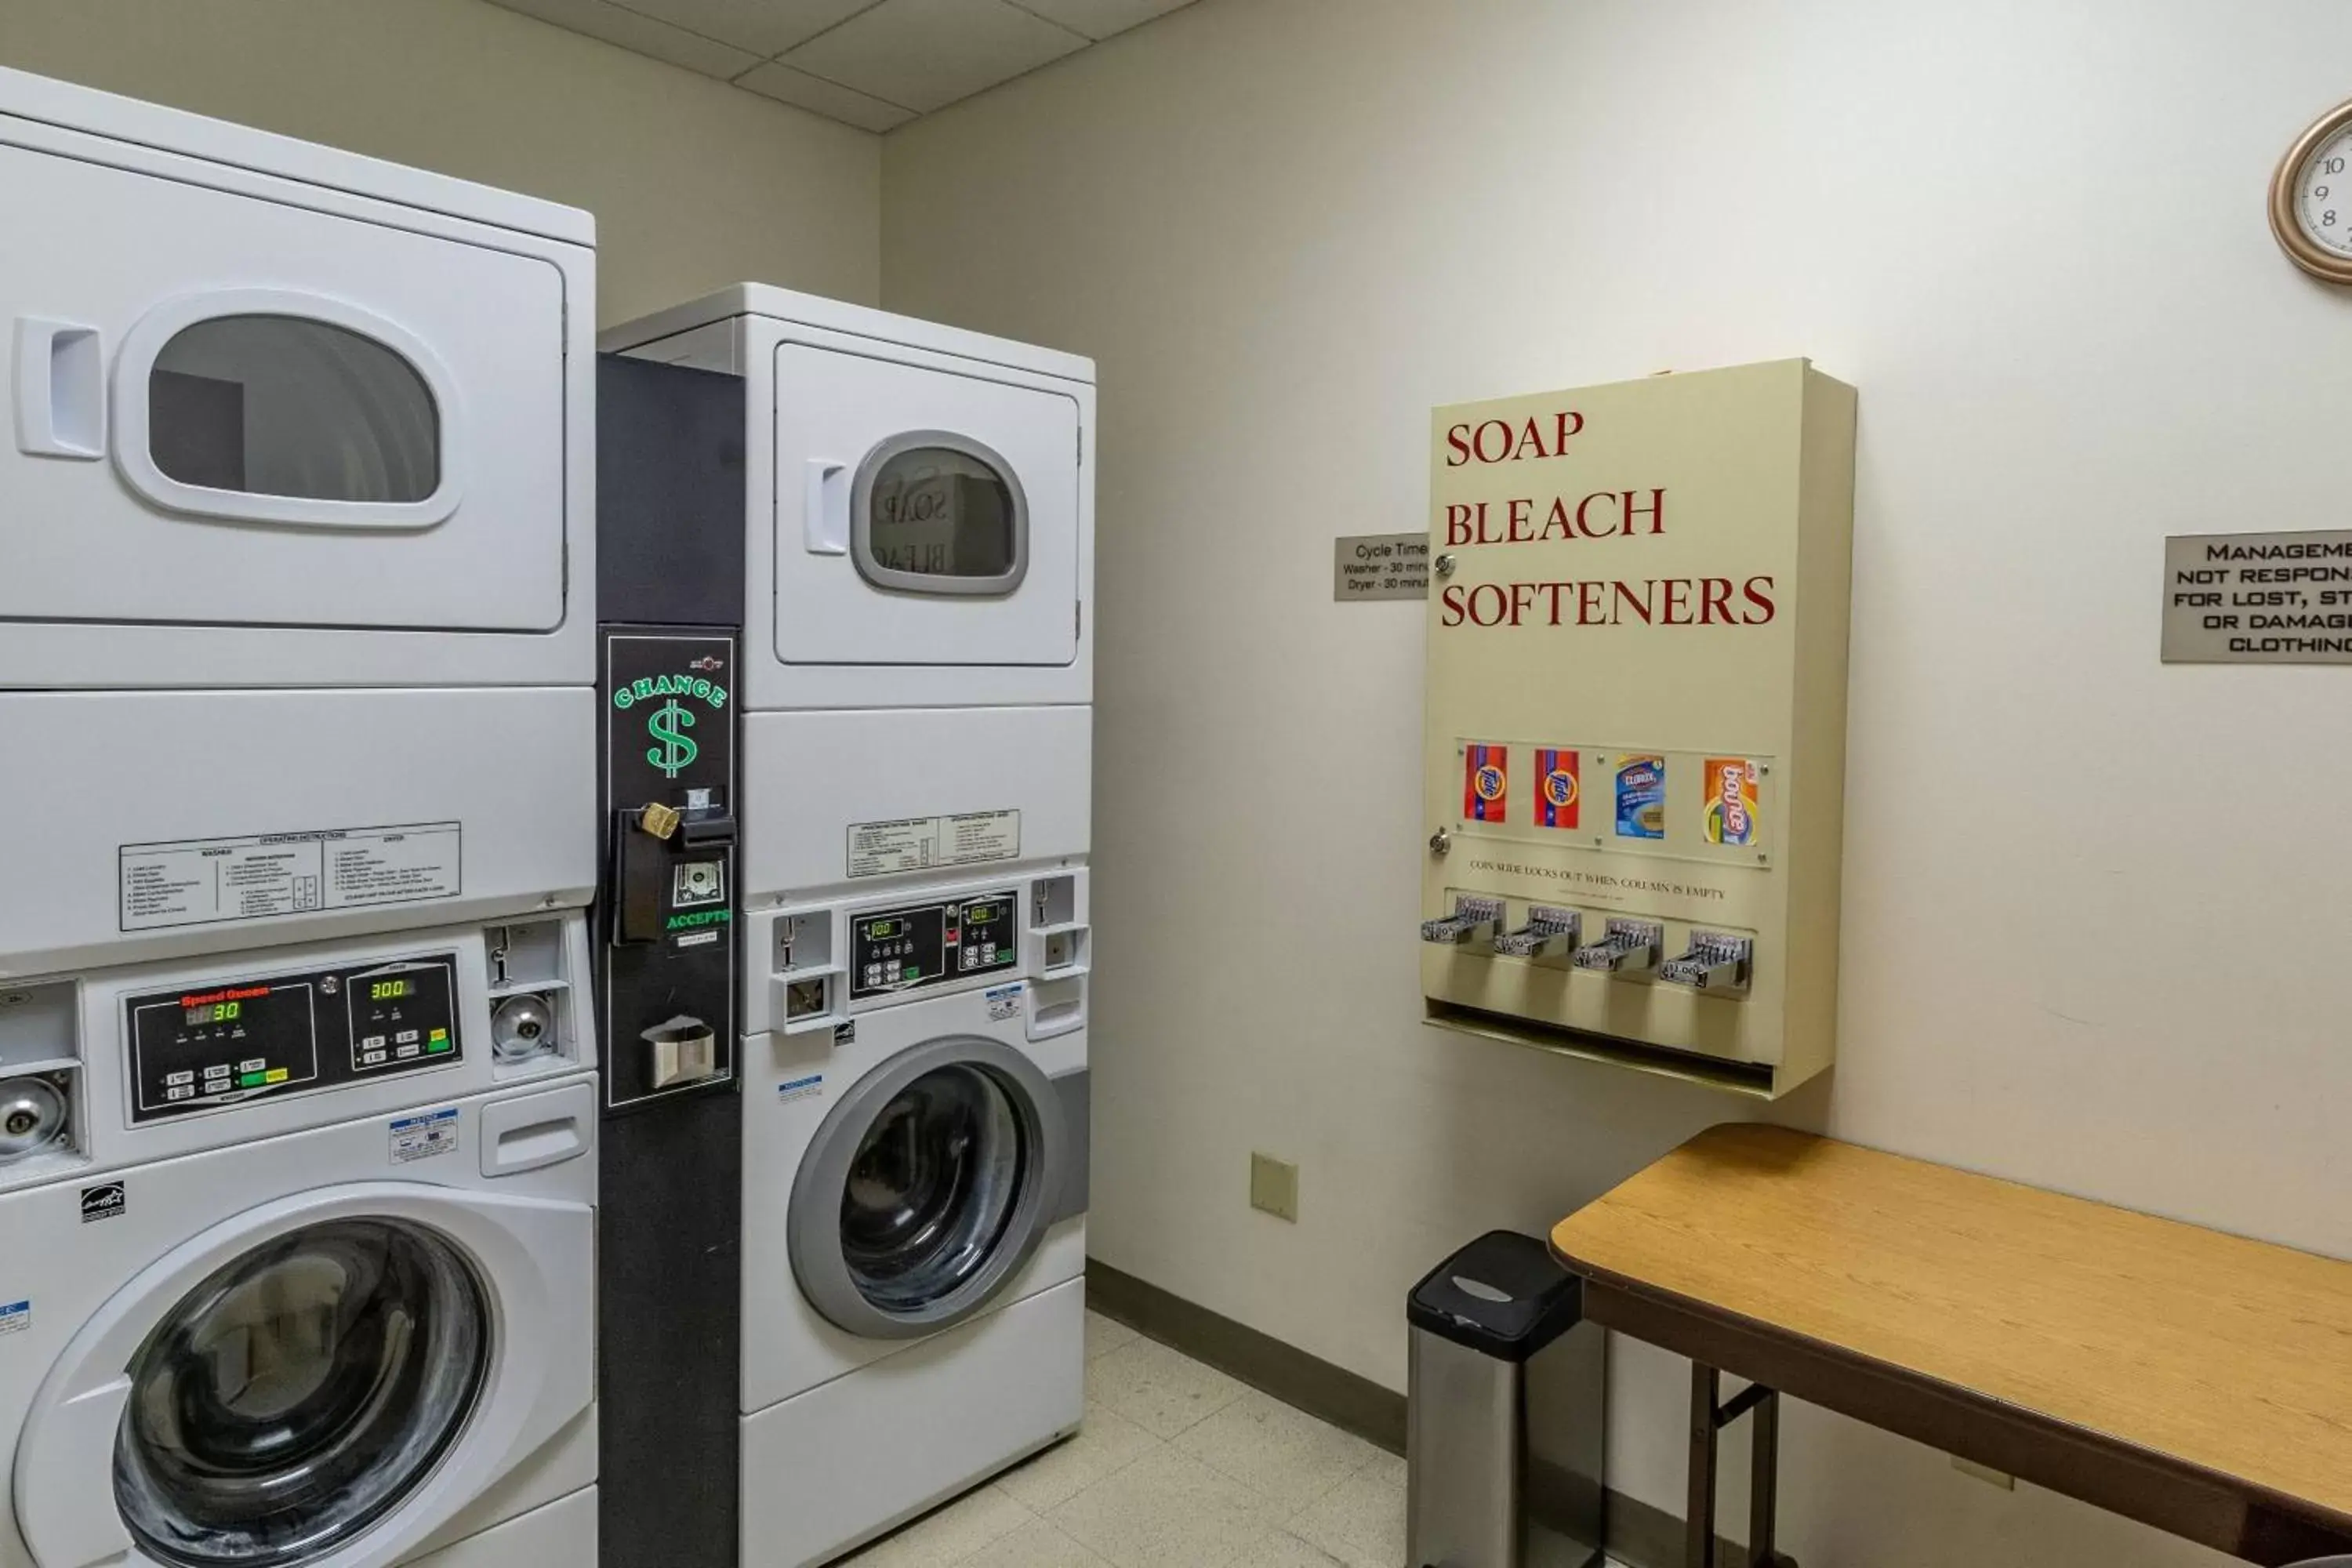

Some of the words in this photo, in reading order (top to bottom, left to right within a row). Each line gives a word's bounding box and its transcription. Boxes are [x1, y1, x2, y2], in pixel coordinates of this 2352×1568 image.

[2325, 158, 2345, 175] 10
[2314, 186, 2329, 201] 9
[2321, 209, 2336, 227] 8
[1446, 412, 1584, 466] SOAP
[1445, 488, 1667, 546] BLEACH
[1356, 543, 1392, 561] Cycle
[1343, 563, 1381, 575] Washer
[1390, 562, 1403, 573] 30
[2176, 569, 2230, 585] NOT
[2239, 566, 2352, 583] RESPON
[1348, 579, 1375, 592] Dryer
[1384, 578, 1398, 589] 30
[1442, 575, 1776, 627] SOFTENERS
[2174, 592, 2223, 607] FOR
[2232, 591, 2309, 609] LOST,
[2203, 615, 2239, 630] OR
[614, 674, 728, 709] CHANGE
[1479, 769, 1498, 797] Tide
[1550, 774, 1569, 803] Tide
[1470, 860, 1494, 870] COIN
[1497, 863, 1522, 874] SLIDE
[1525, 866, 1557, 878] LOCKS
[1559, 870, 1582, 882] OUT
[1585, 873, 1617, 886] WHEN
[1621, 877, 1670, 892] COLUMN
[1673, 884, 1683, 894] IS
[1686, 886, 1726, 900] EMPTY
[667, 909, 731, 929] ACCEPTS
[181, 993, 225, 1007] Speed
[227, 986, 270, 1000] Queen
[214, 1002, 239, 1021] 30
